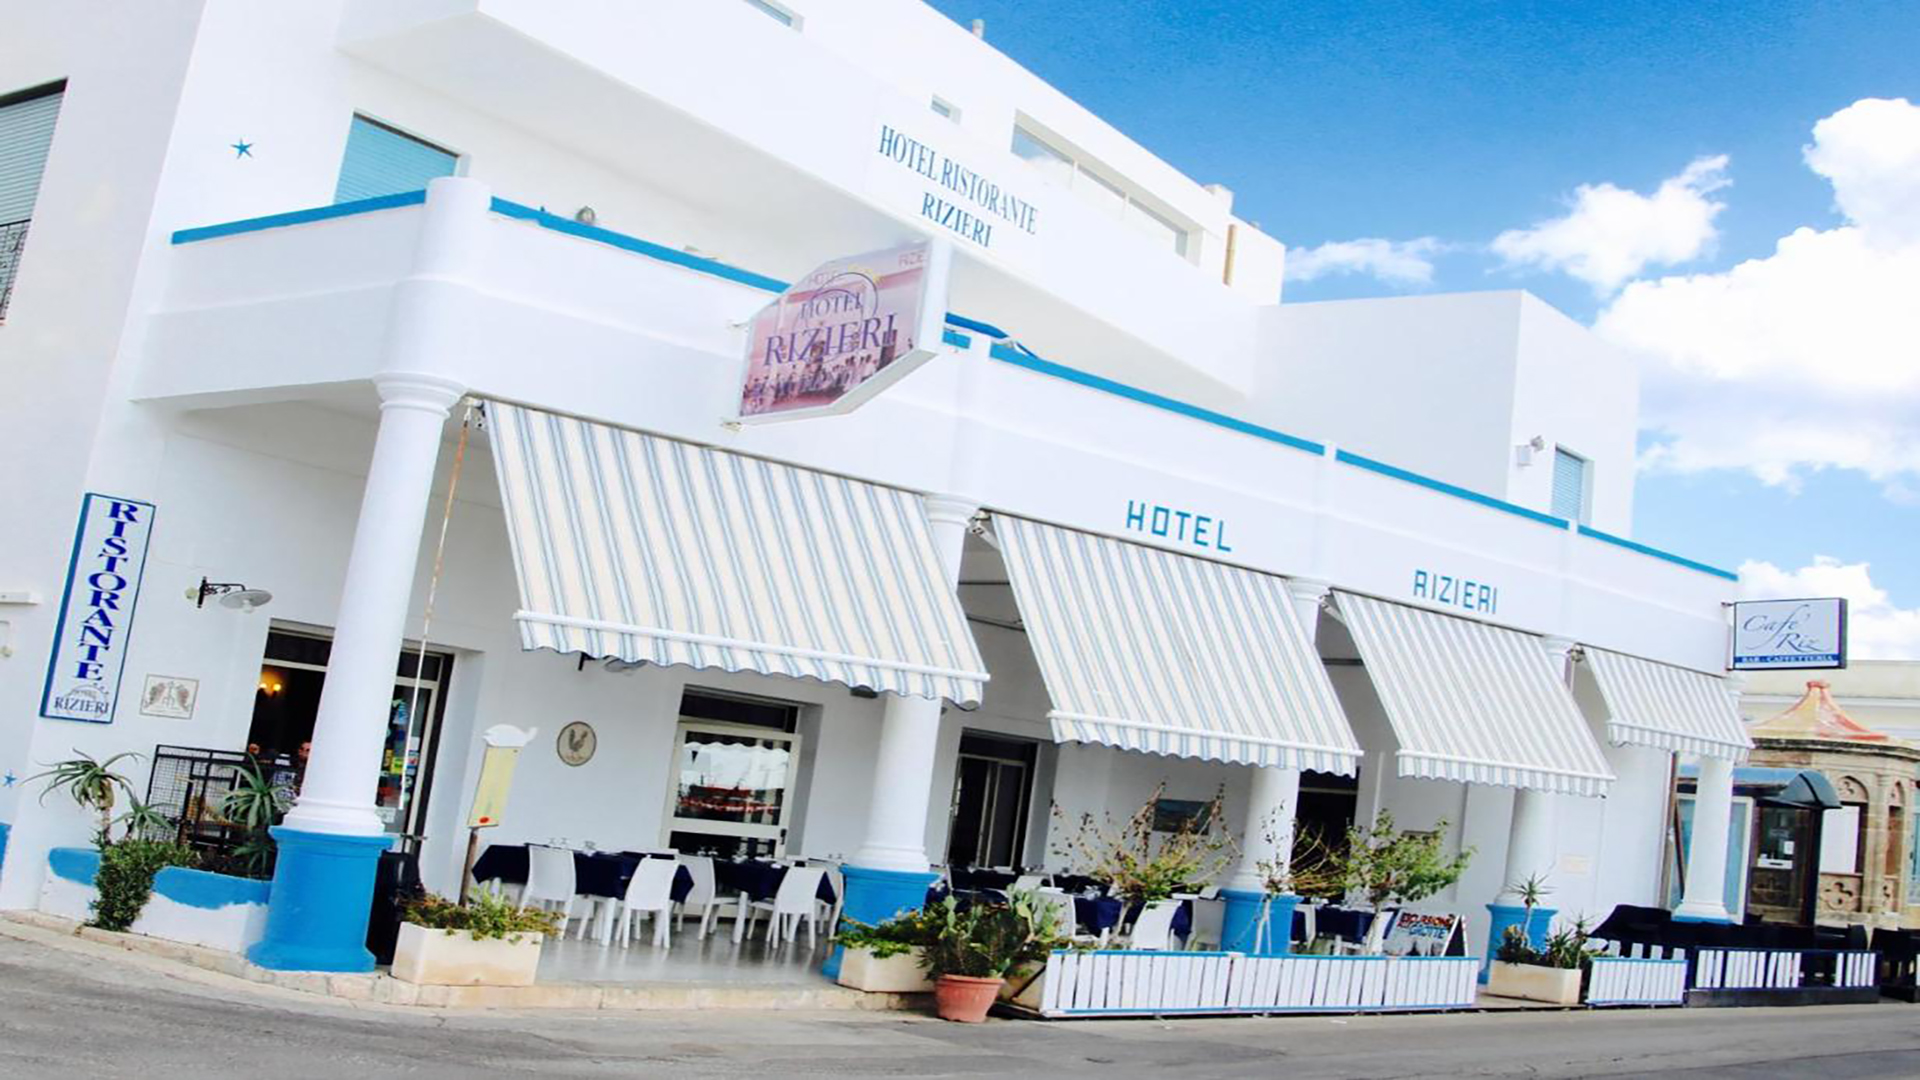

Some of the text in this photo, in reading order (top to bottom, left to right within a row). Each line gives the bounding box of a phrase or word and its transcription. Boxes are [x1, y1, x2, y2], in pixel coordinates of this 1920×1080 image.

[878, 124, 1039, 235] HOTEL RISTORANTE
[921, 191, 993, 249] RIZIERI
[800, 291, 864, 319] HOTEL
[763, 313, 898, 367] RIZIERI
[1126, 499, 1233, 553] HOTEL
[74, 501, 139, 681] RISTORANTE
[1413, 568, 1498, 615] RIZIERI
[54, 696, 110, 714] RIZIERI
